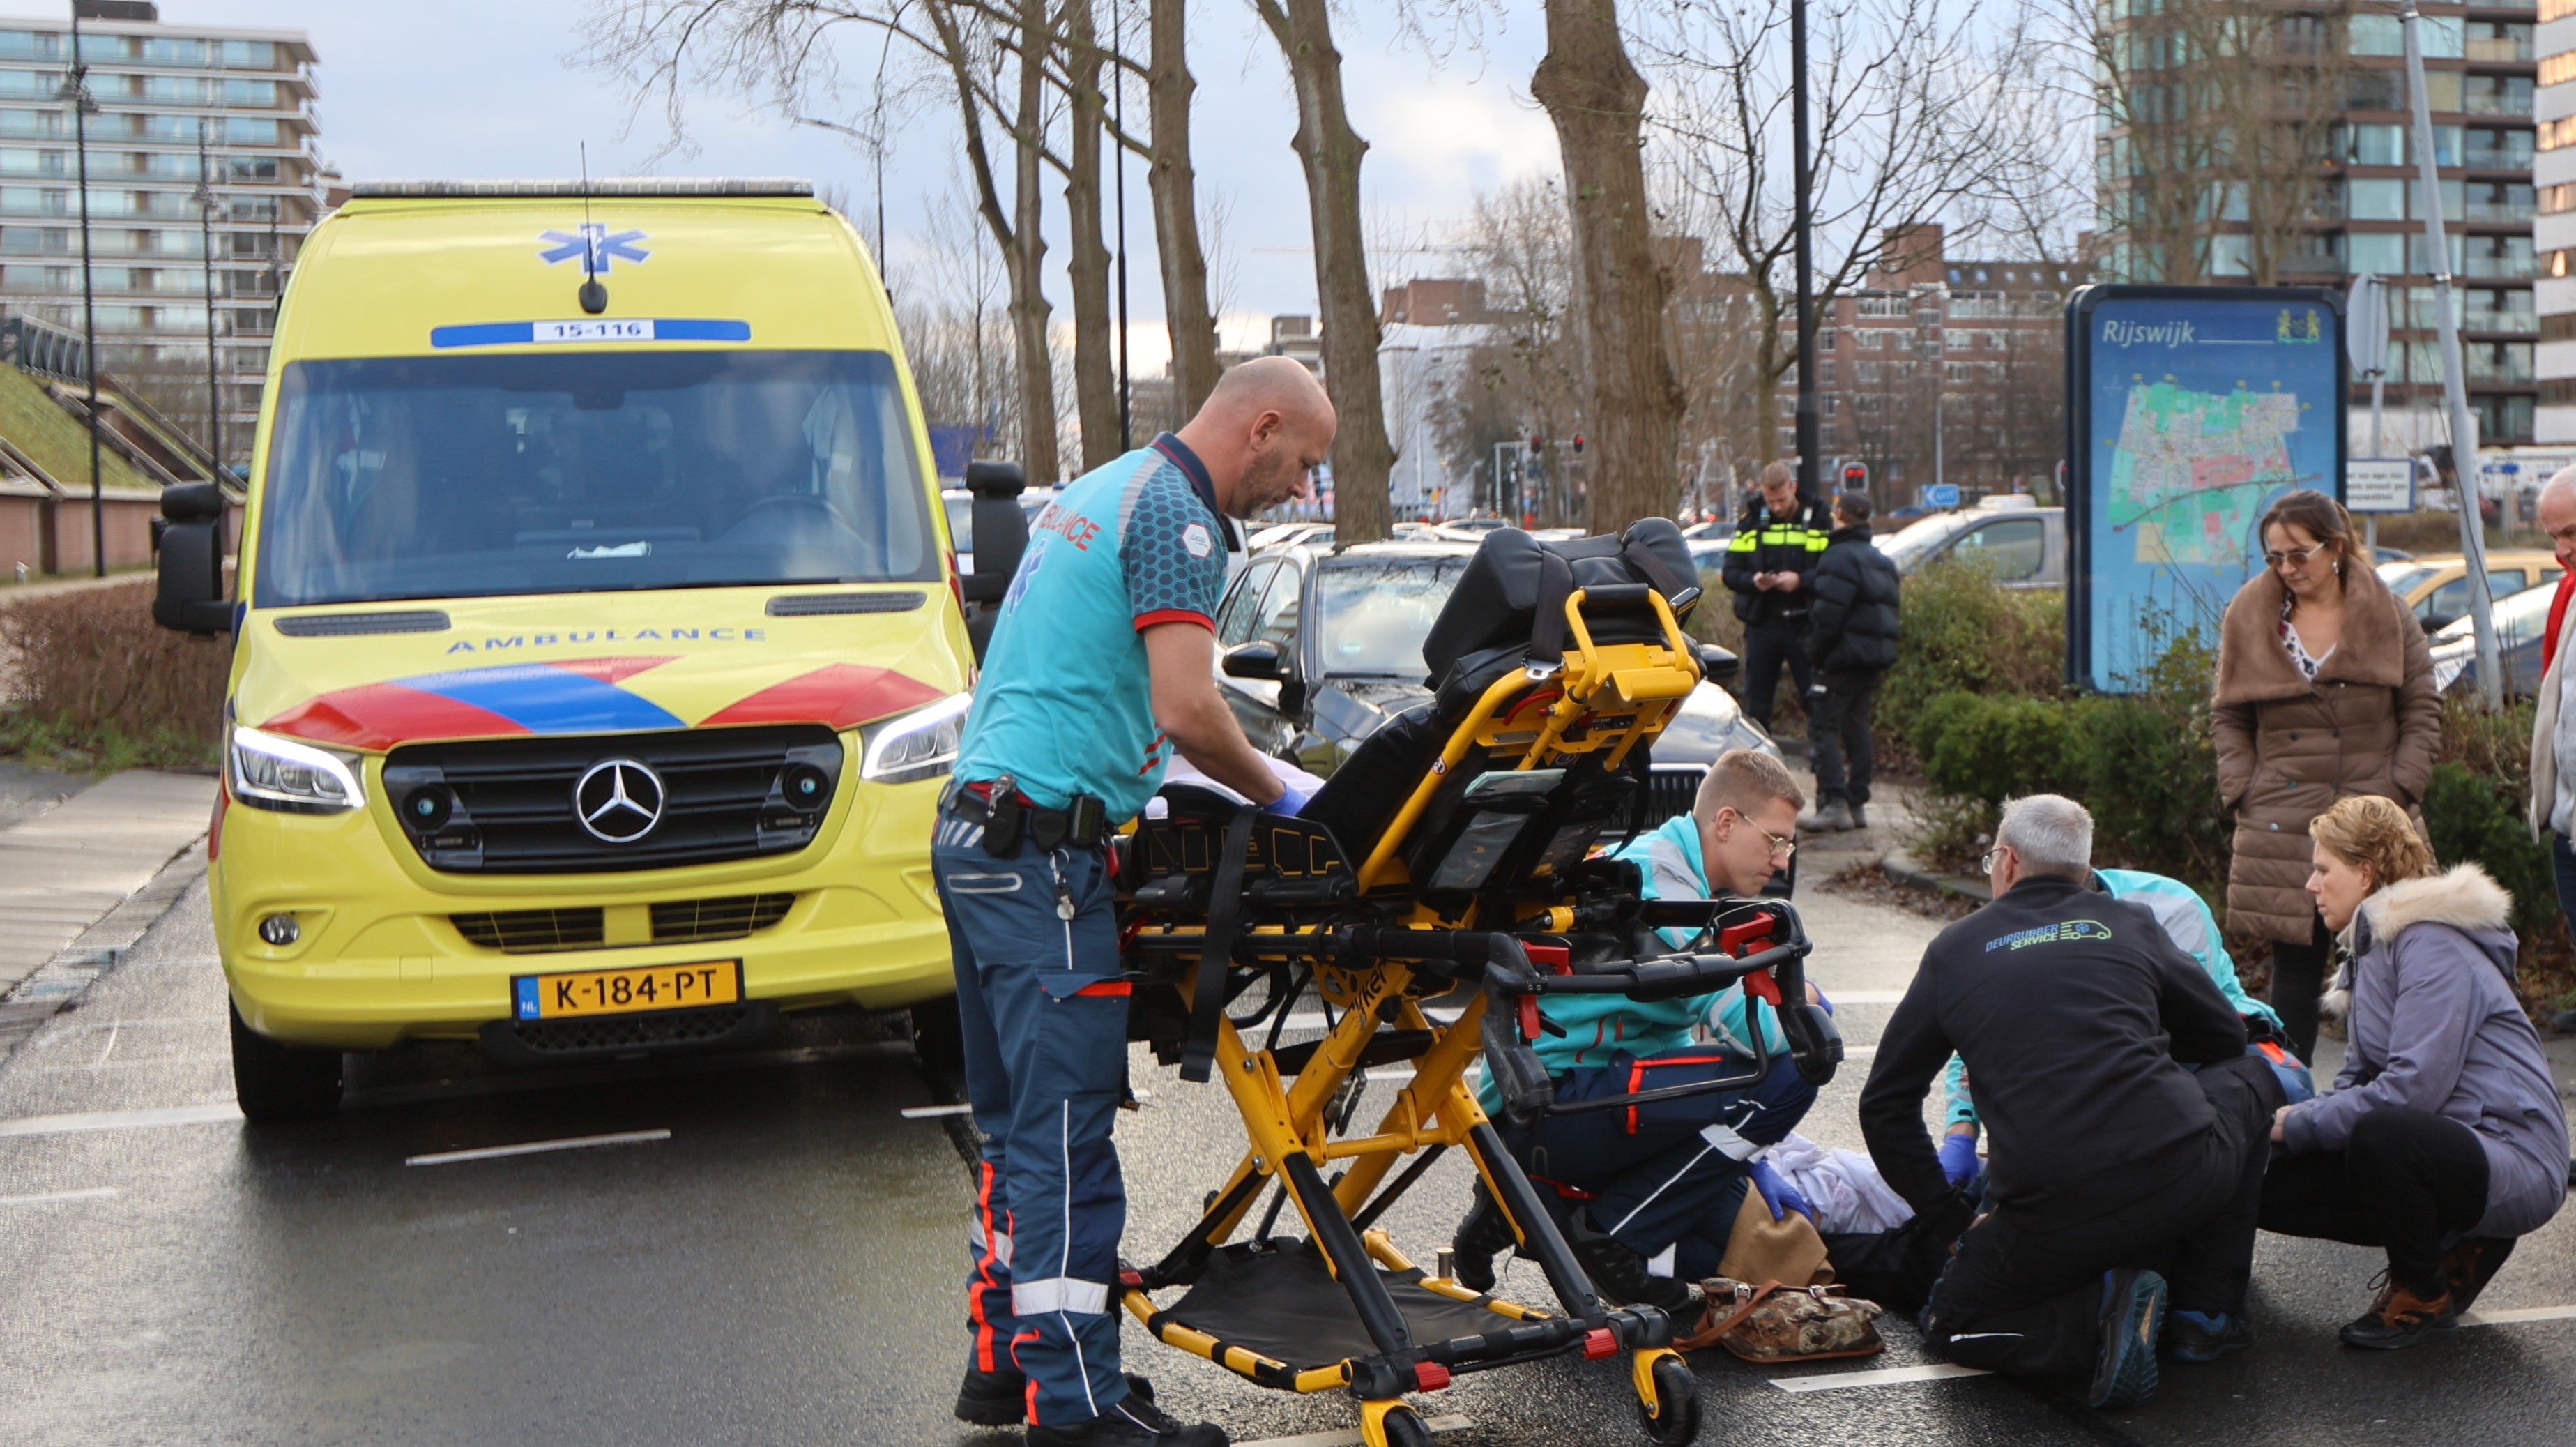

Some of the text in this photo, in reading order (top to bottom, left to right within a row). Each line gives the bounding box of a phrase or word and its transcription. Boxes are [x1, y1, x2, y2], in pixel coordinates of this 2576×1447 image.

[554, 323, 641, 337] 15-116
[2103, 320, 2195, 348] Rijswijk
[445, 628, 767, 655] AMBULANCE
[1986, 923, 2059, 953] DEURRUBBER
[2010, 932, 2059, 951] SERVICE
[556, 969, 717, 1009] K-184-PT
[521, 1000, 538, 1013] NL
